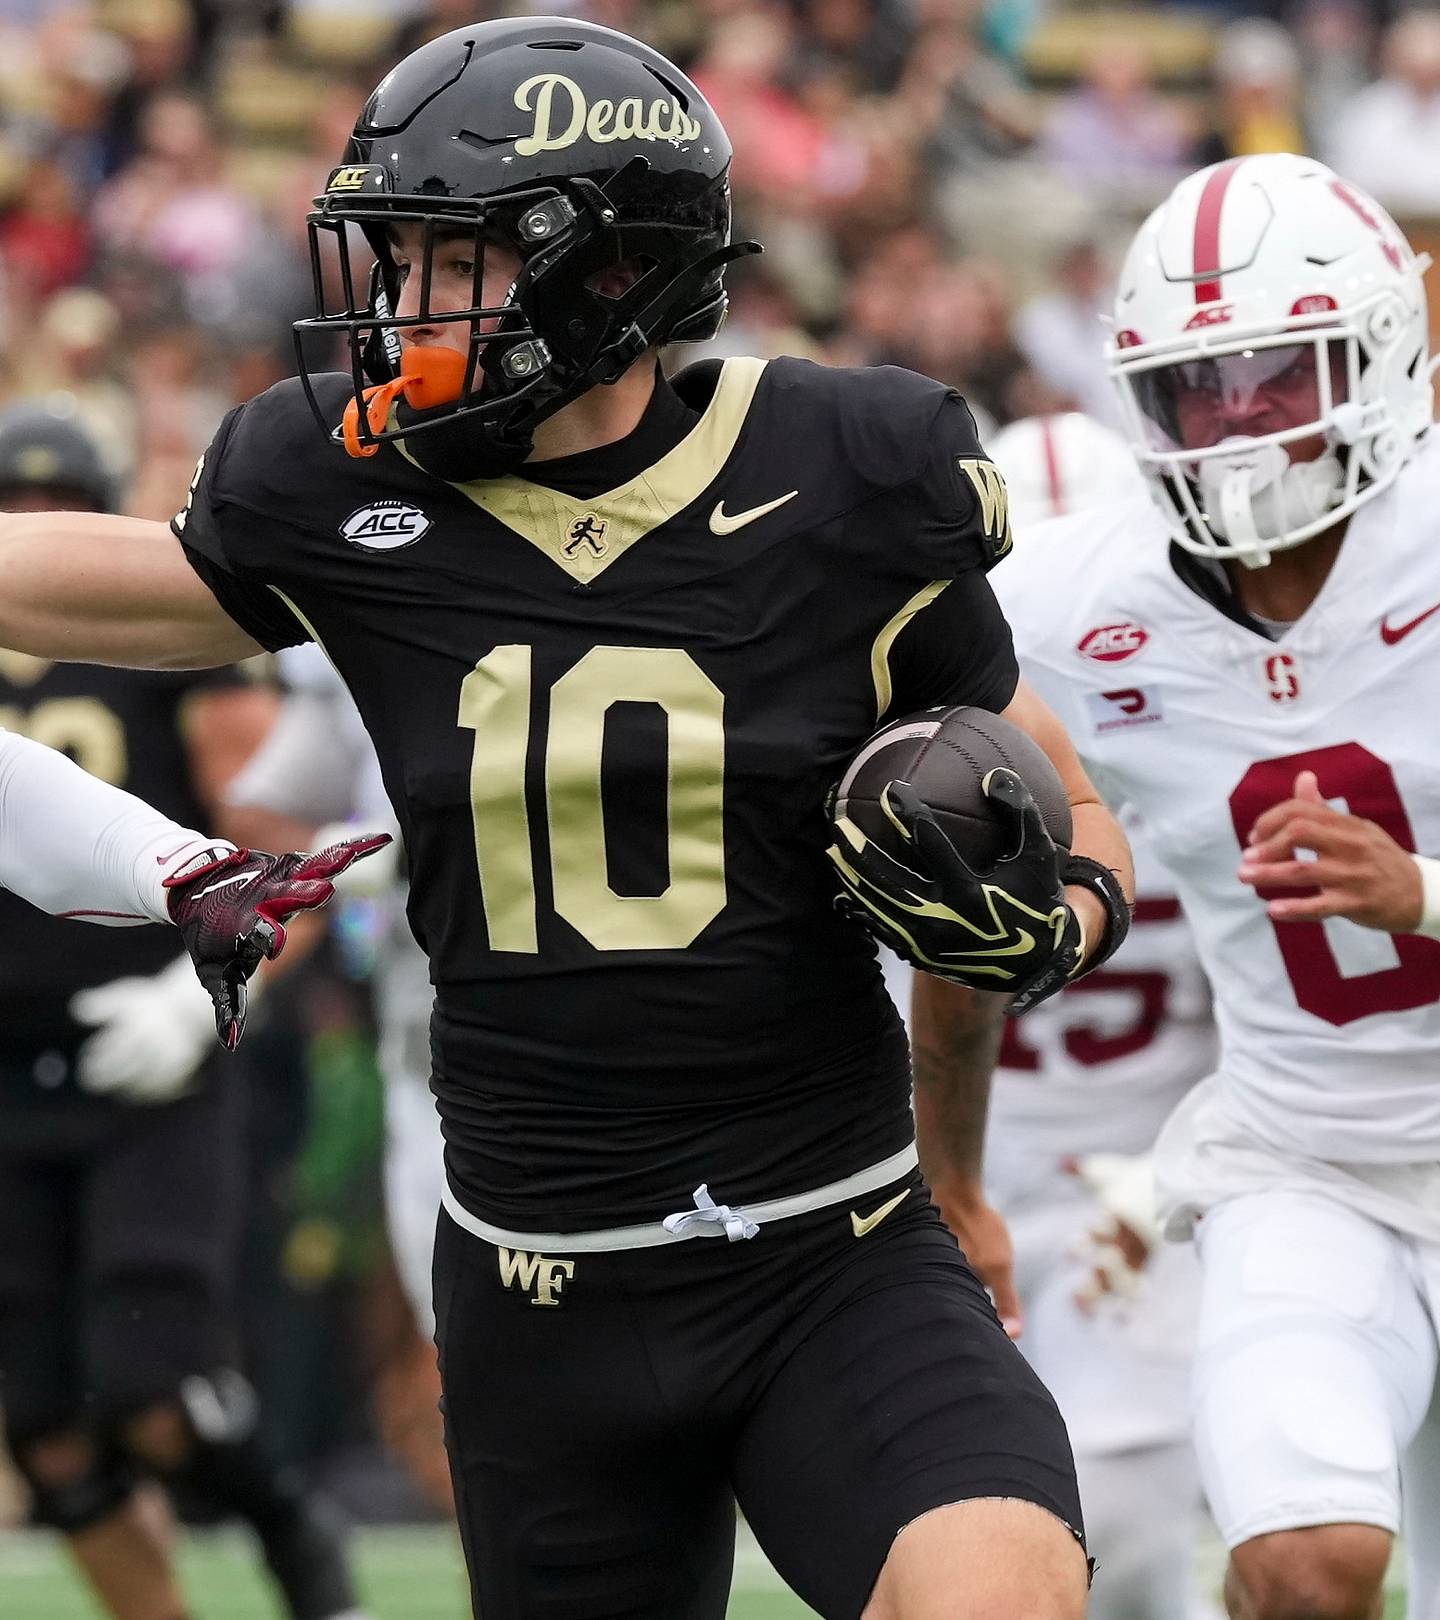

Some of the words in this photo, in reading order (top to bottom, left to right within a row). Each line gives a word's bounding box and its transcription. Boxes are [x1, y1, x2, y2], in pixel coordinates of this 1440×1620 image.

[513, 73, 701, 157] Deacs
[353, 511, 422, 534] ACC
[457, 644, 728, 954] 10
[498, 1246, 575, 1306] WF
